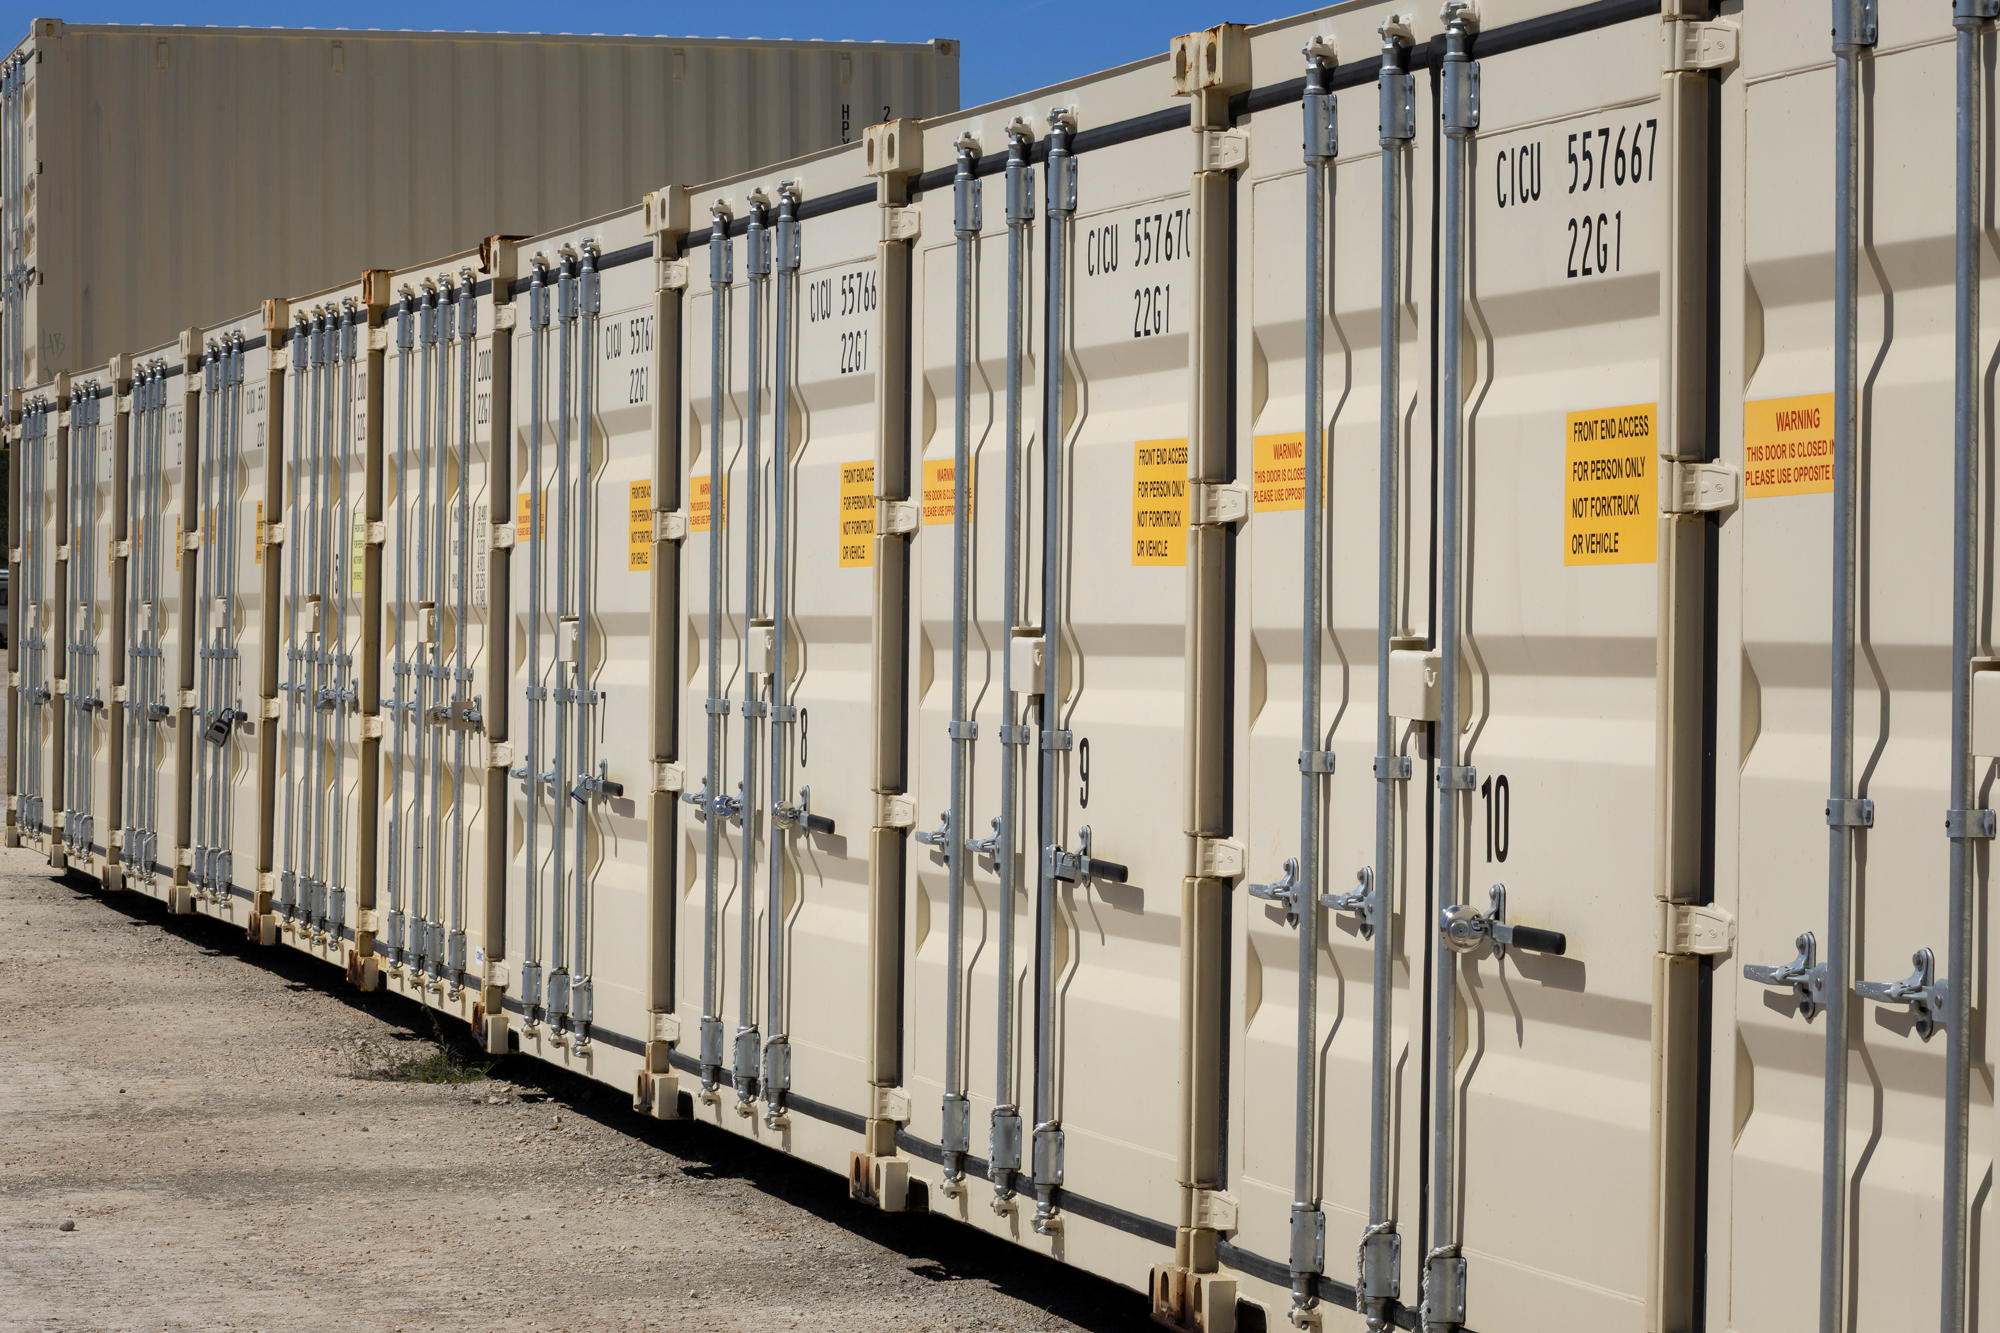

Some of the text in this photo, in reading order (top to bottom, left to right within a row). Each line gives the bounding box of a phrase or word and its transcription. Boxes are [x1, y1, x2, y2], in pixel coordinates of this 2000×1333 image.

[1497, 118, 1657, 208] CICU 557667
[1088, 224, 1118, 276] CICU
[1567, 210, 1621, 278] 22G1
[810, 270, 876, 322] CICU 55766
[1134, 284, 1170, 338] 22G1
[606, 322, 621, 360] CICU
[841, 329, 867, 374] 22G1
[630, 366, 648, 404] 22G1
[478, 392, 490, 424] 22G1
[1776, 408, 1820, 432] WARNING
[1574, 414, 1649, 442] FRONT END ACCESS
[1139, 447, 1188, 466] FRONT END ACCESS
[1273, 442, 1302, 460] WARNING
[1747, 446, 1763, 462] THIS
[1766, 444, 1787, 460] DOOR
[1789, 442, 1795, 459] IS
[1797, 440, 1827, 458] CLOSED
[844, 469, 856, 484] FRONT
[1254, 470, 1266, 483] THIS
[1267, 470, 1281, 482] DOOR
[1282, 469, 1286, 482] IS
[1572, 456, 1645, 482] FOR PERSON ONLY
[1745, 469, 1775, 486] PLEASE
[1777, 468, 1791, 484] USE
[1794, 464, 1830, 482] OPPOSITE
[1138, 480, 1185, 497] FOR PERSON ONLY
[1254, 489, 1273, 503] PLEASE
[1274, 489, 1284, 501] USE
[852, 496, 866, 510] PERSON
[923, 506, 937, 517] PLEASE
[1572, 494, 1640, 518] NOT FORKTRUCK
[852, 520, 874, 535] FORKTRUCK
[1137, 510, 1181, 527] NOT FORKTRUCK
[843, 545, 865, 560] OR VEHICLE
[1137, 540, 1168, 556] OR VEHICLE
[1572, 532, 1619, 554] OR VEHICLE
[601, 692, 606, 743] 7
[801, 708, 808, 767] 8
[1079, 738, 1089, 809] 9
[1482, 774, 1510, 863] 10
